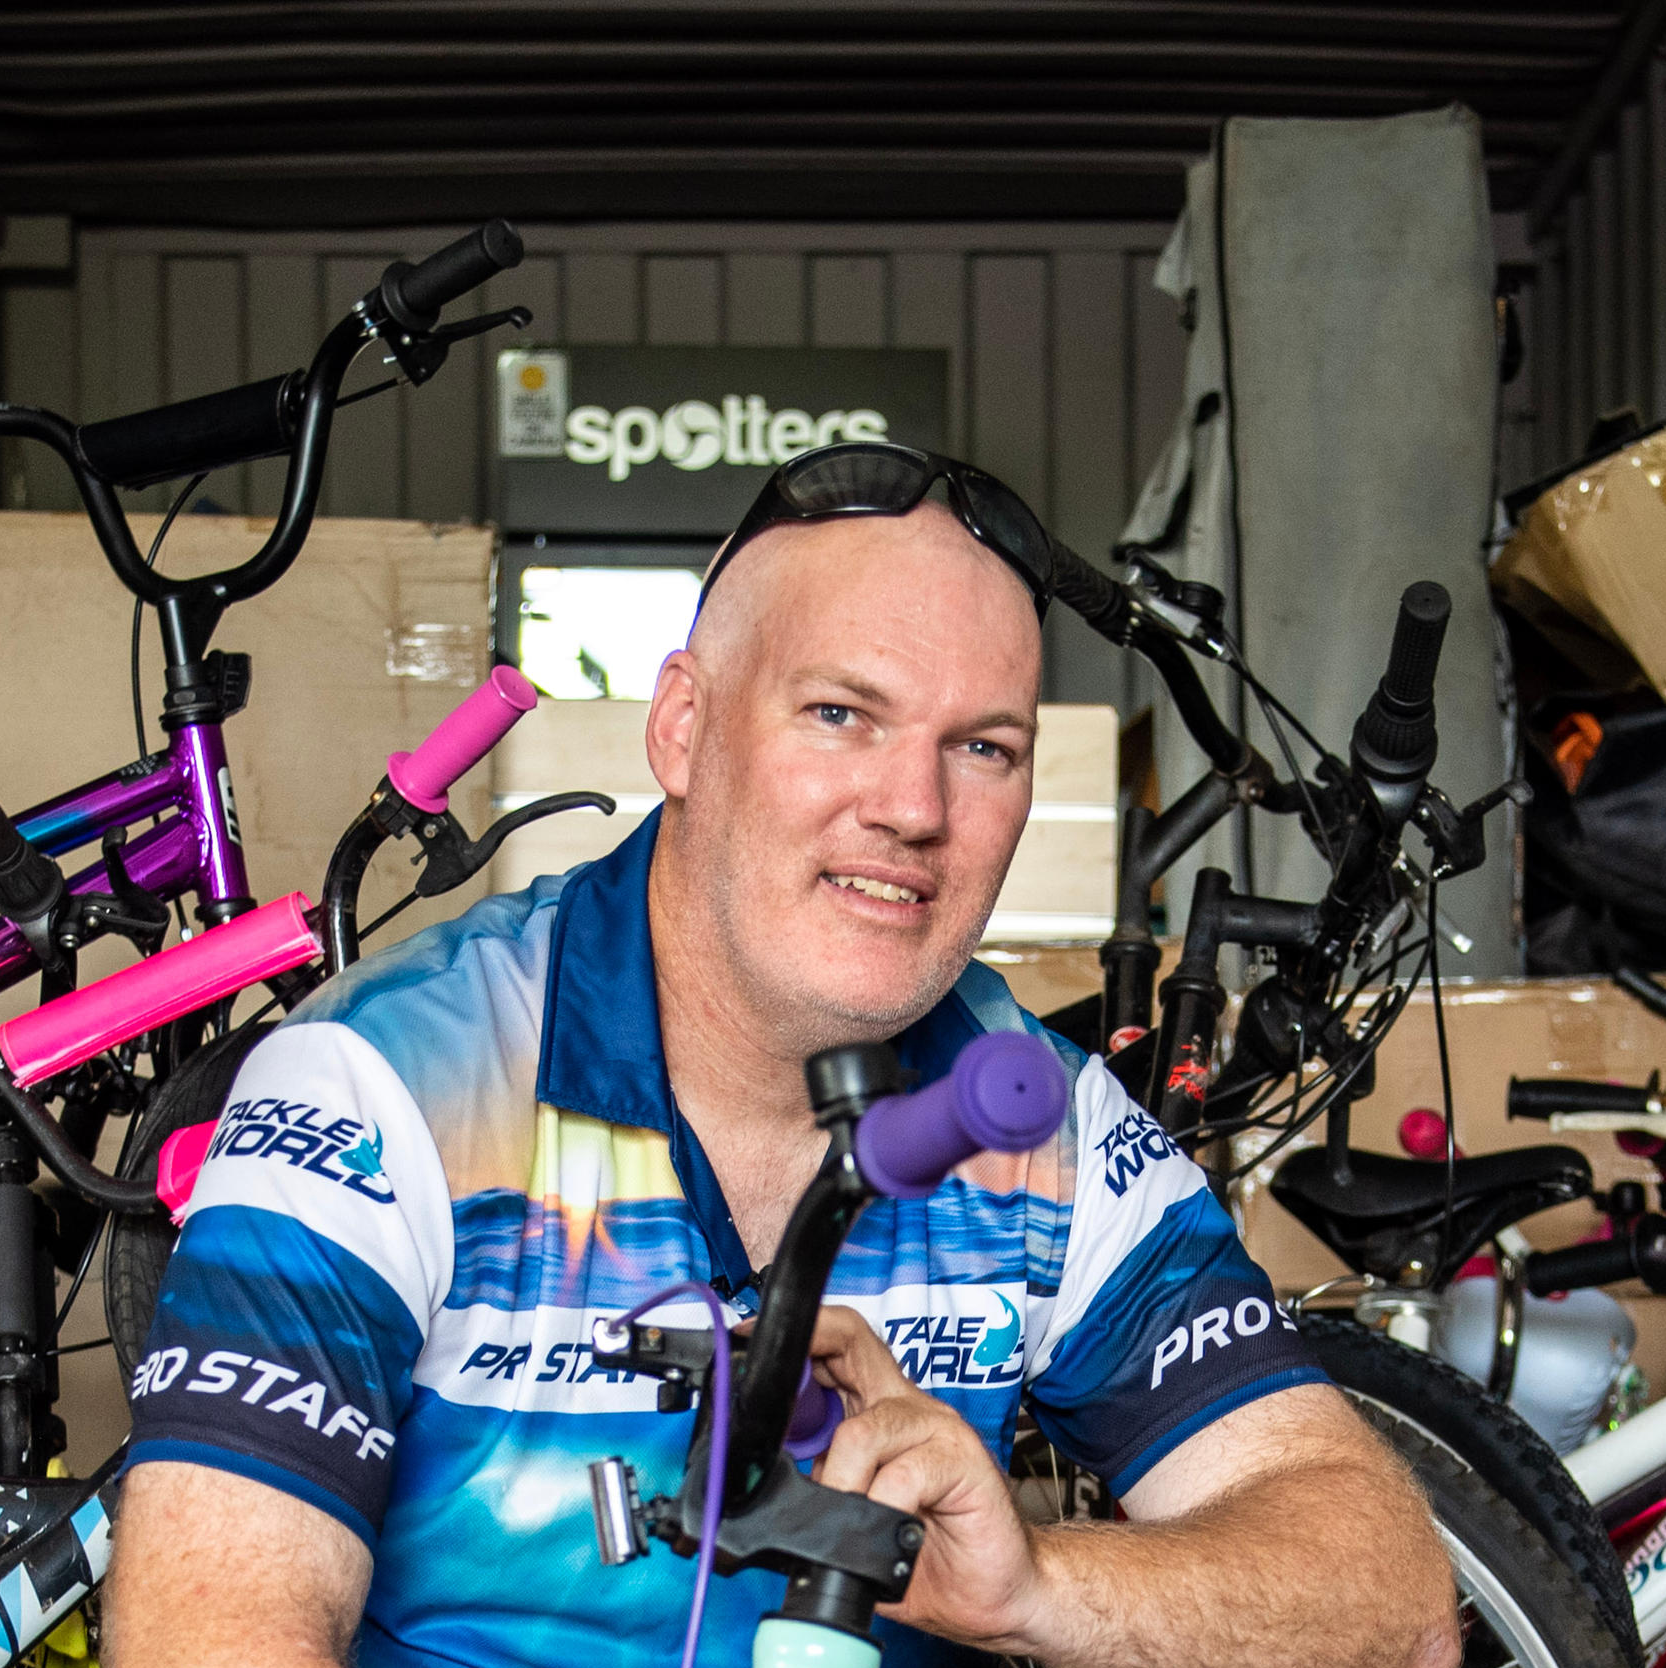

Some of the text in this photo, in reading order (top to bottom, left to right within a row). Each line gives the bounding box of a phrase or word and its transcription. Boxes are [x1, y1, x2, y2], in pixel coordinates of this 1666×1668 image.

[218, 1098, 365, 1147] TACKLE
[1151, 1296, 1271, 1391] PRO
[185, 1350, 397, 1461] STAFF
